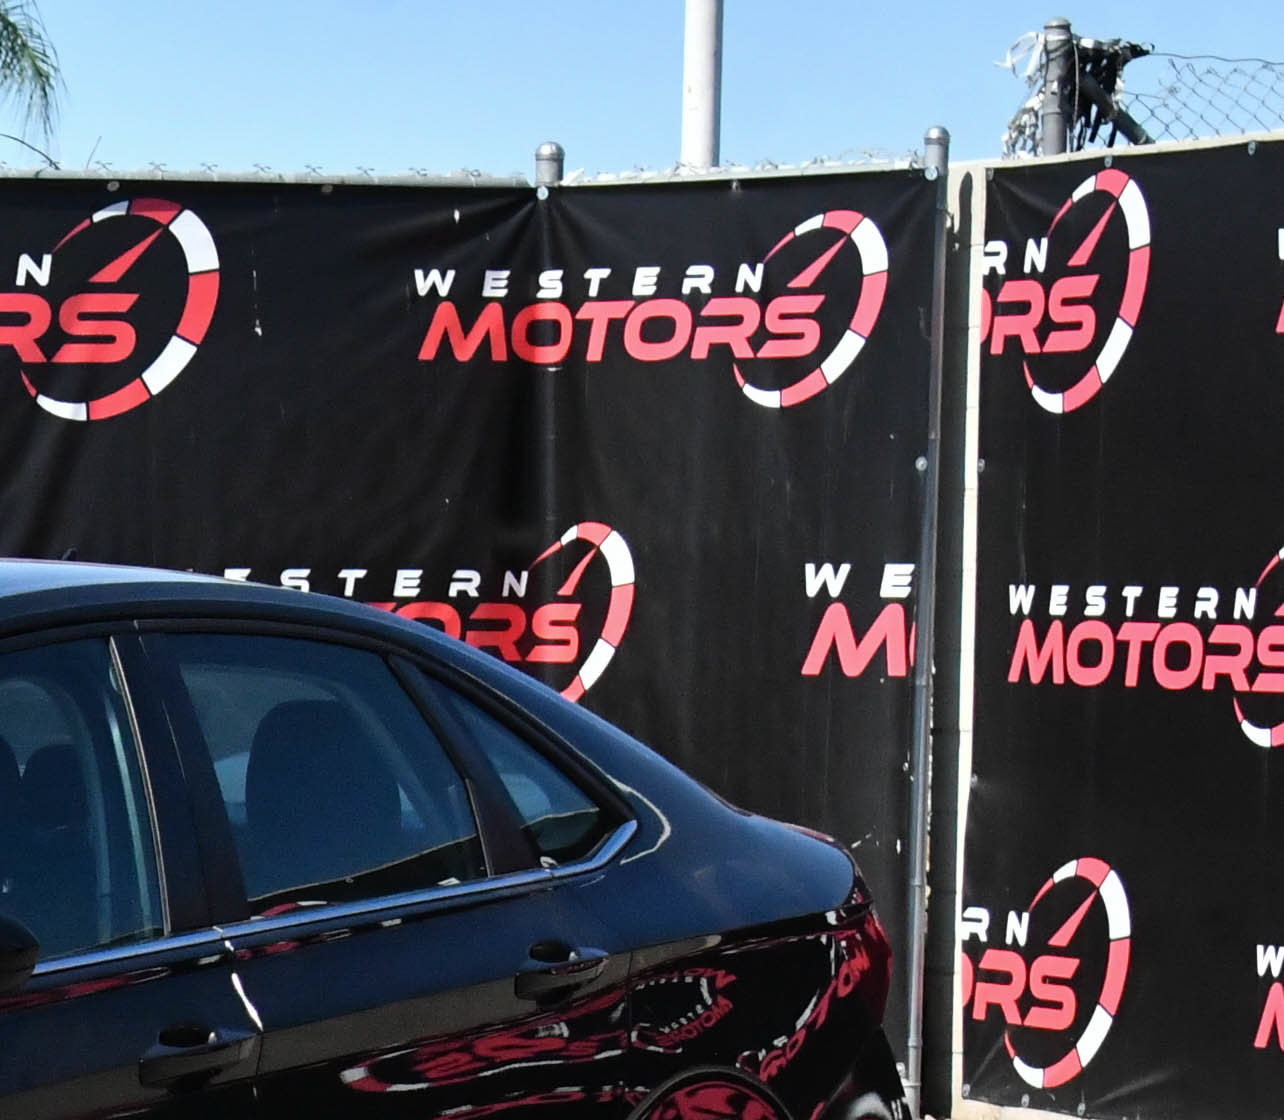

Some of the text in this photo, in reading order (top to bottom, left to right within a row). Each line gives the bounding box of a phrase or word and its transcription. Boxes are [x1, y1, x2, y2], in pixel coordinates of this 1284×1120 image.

[414, 263, 764, 298] WESTERN
[419, 294, 825, 363] MOTORS
[1009, 584, 1256, 619] WESTERN
